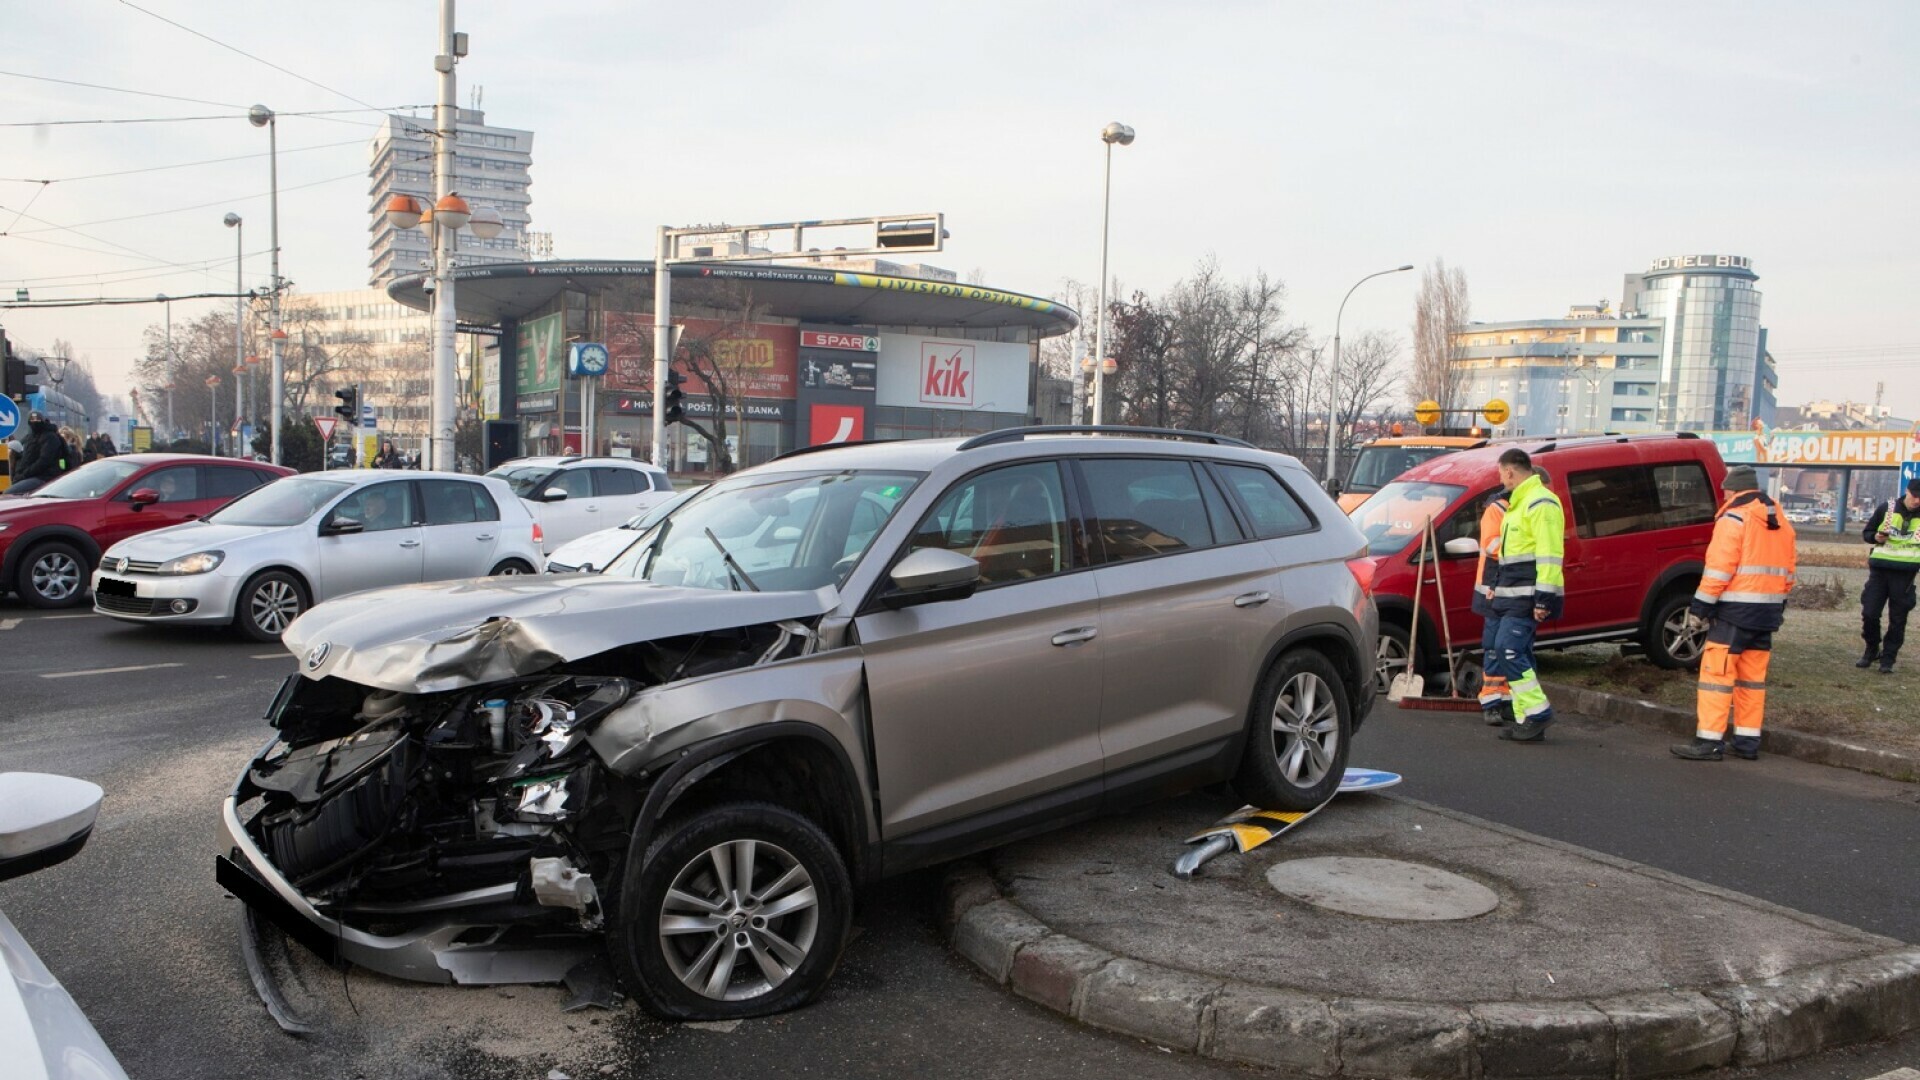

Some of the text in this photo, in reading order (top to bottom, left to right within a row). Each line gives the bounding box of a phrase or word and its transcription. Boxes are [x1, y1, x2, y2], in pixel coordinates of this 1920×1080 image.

[1650, 255, 1709, 270] HOTEL
[713, 270, 834, 282] HRVATSKA POŠTANSKA BANKA
[876, 278, 1023, 307] LIVISION OPTIKA
[816, 334, 862, 348] SPAR
[923, 351, 970, 398] kik
[747, 406, 781, 415] BANKA
[1732, 439, 1752, 453] JUG
